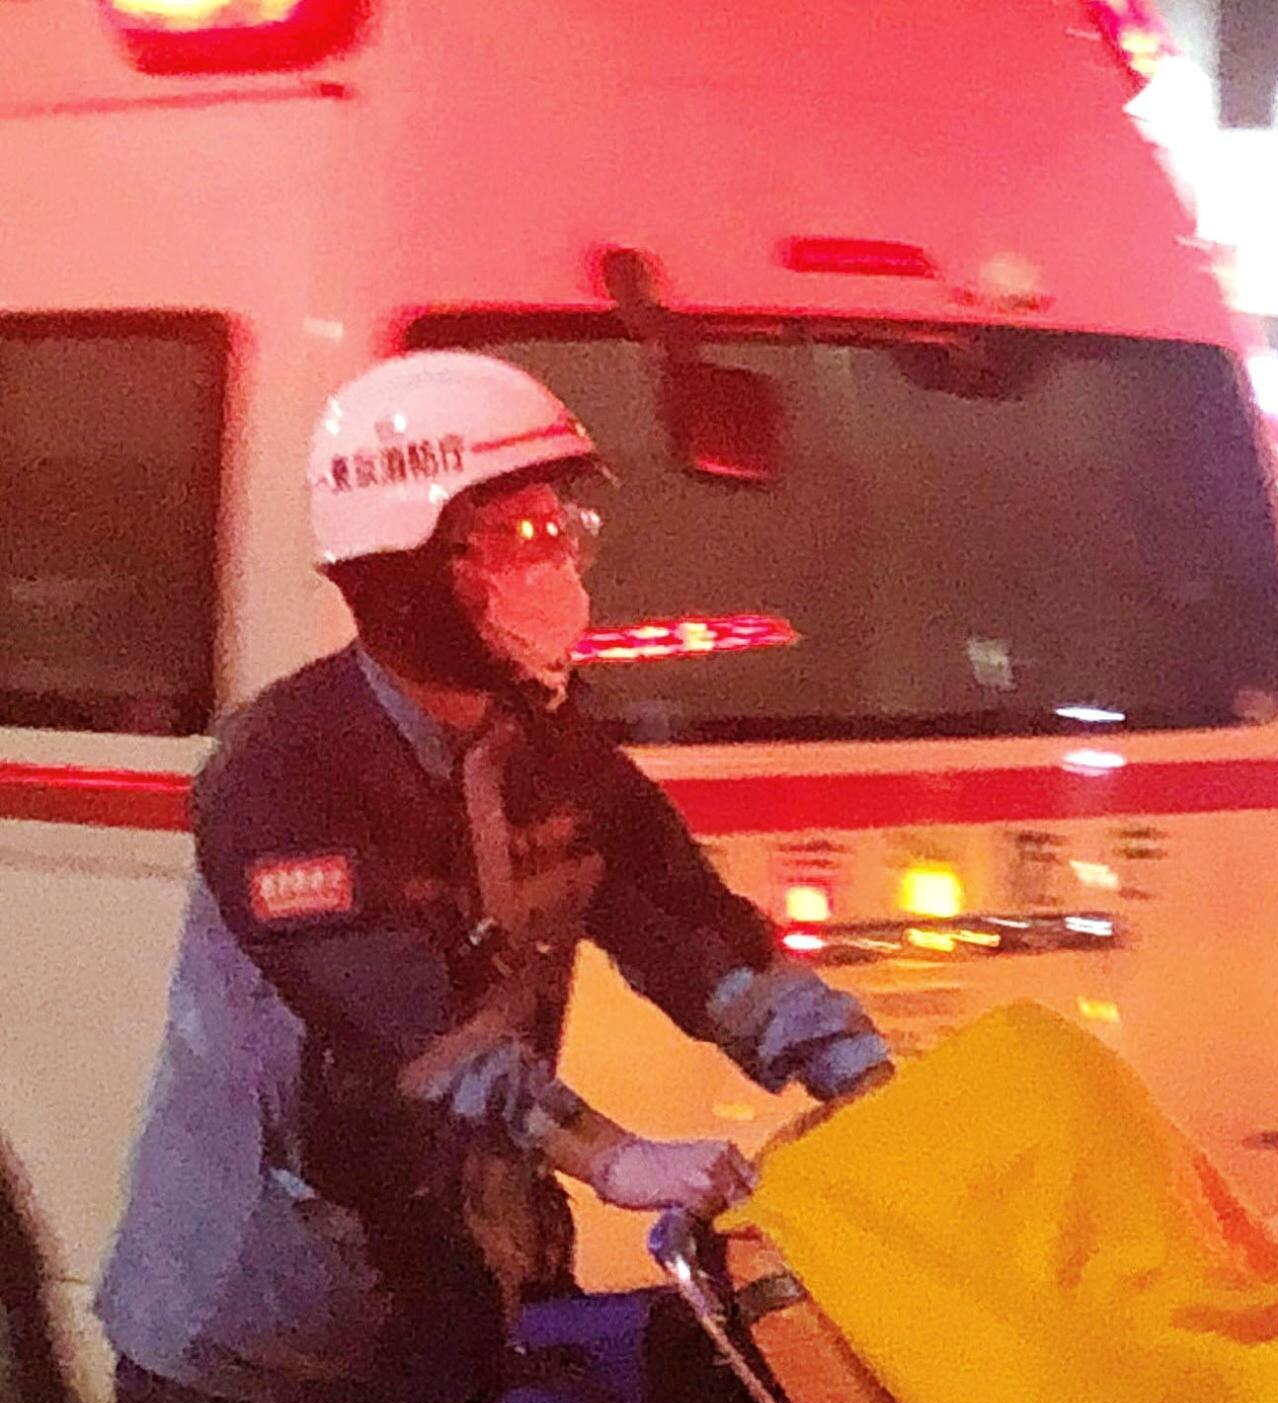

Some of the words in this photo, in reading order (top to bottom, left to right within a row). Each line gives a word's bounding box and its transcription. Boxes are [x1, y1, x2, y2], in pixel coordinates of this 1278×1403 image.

[330, 434, 464, 493] 東京消防庁
